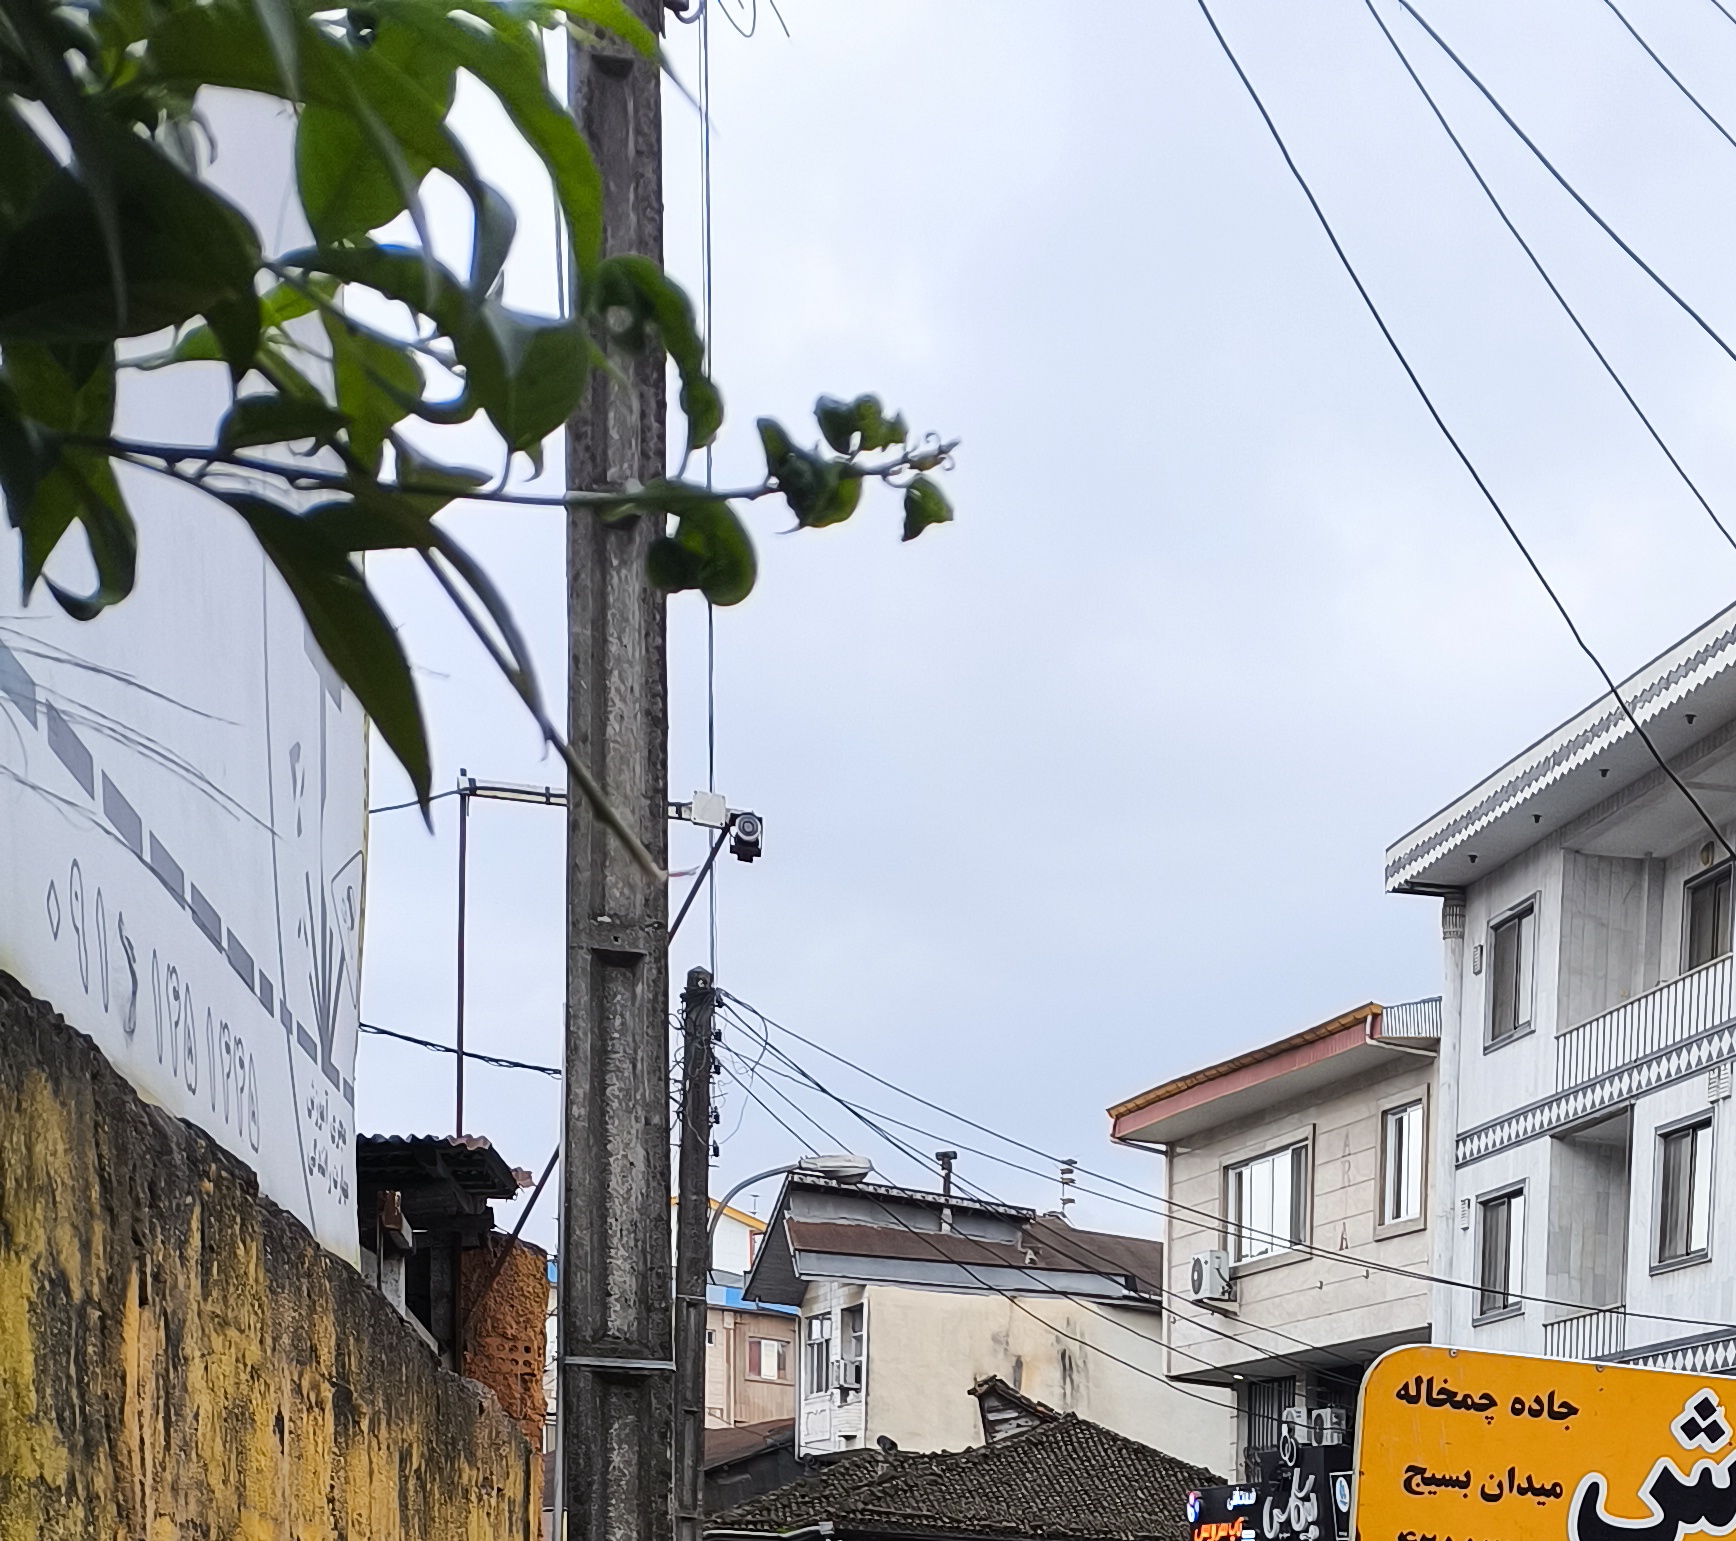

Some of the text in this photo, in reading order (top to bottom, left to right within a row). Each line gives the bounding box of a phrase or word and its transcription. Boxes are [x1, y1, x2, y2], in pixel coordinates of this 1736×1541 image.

[1395, 1374, 1580, 1431] جاده چمخاله
[1403, 1464, 1563, 1506] میدان بسیج
